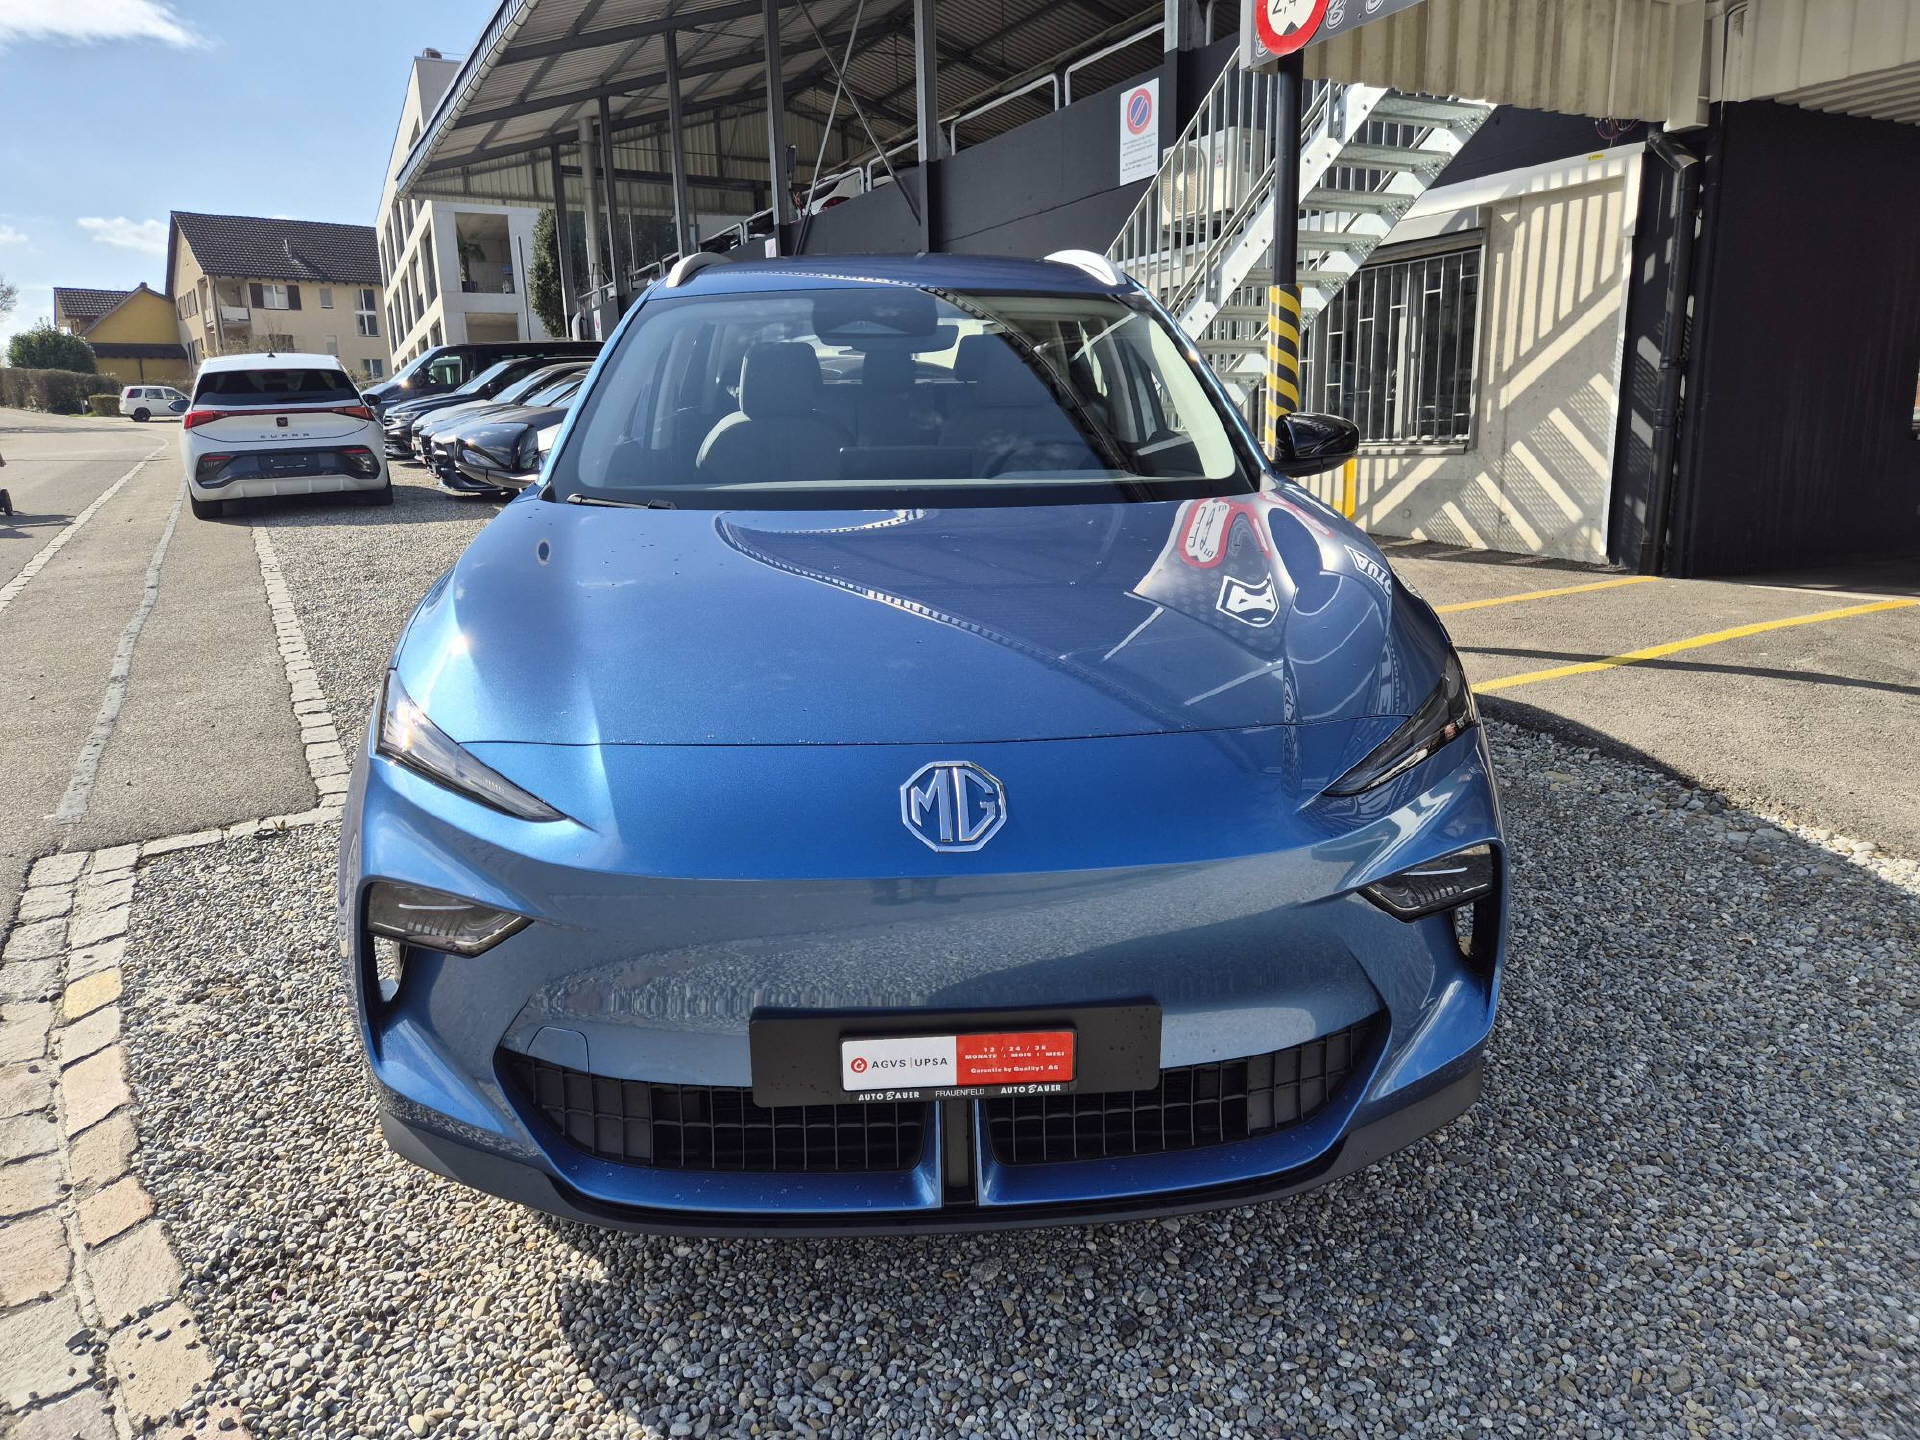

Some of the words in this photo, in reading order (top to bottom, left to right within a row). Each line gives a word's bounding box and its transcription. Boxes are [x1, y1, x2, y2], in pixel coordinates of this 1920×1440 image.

[910, 766, 996, 842] MG
[872, 1060, 906, 1069] AGVS
[914, 1057, 948, 1067] UPSA
[935, 1088, 985, 1097] FRAUENFELD
[1000, 1086, 1026, 1094] AUTO
[1028, 1084, 1061, 1094] BAUER
[858, 1093, 884, 1101] AUTO
[886, 1091, 920, 1101] BAUER
